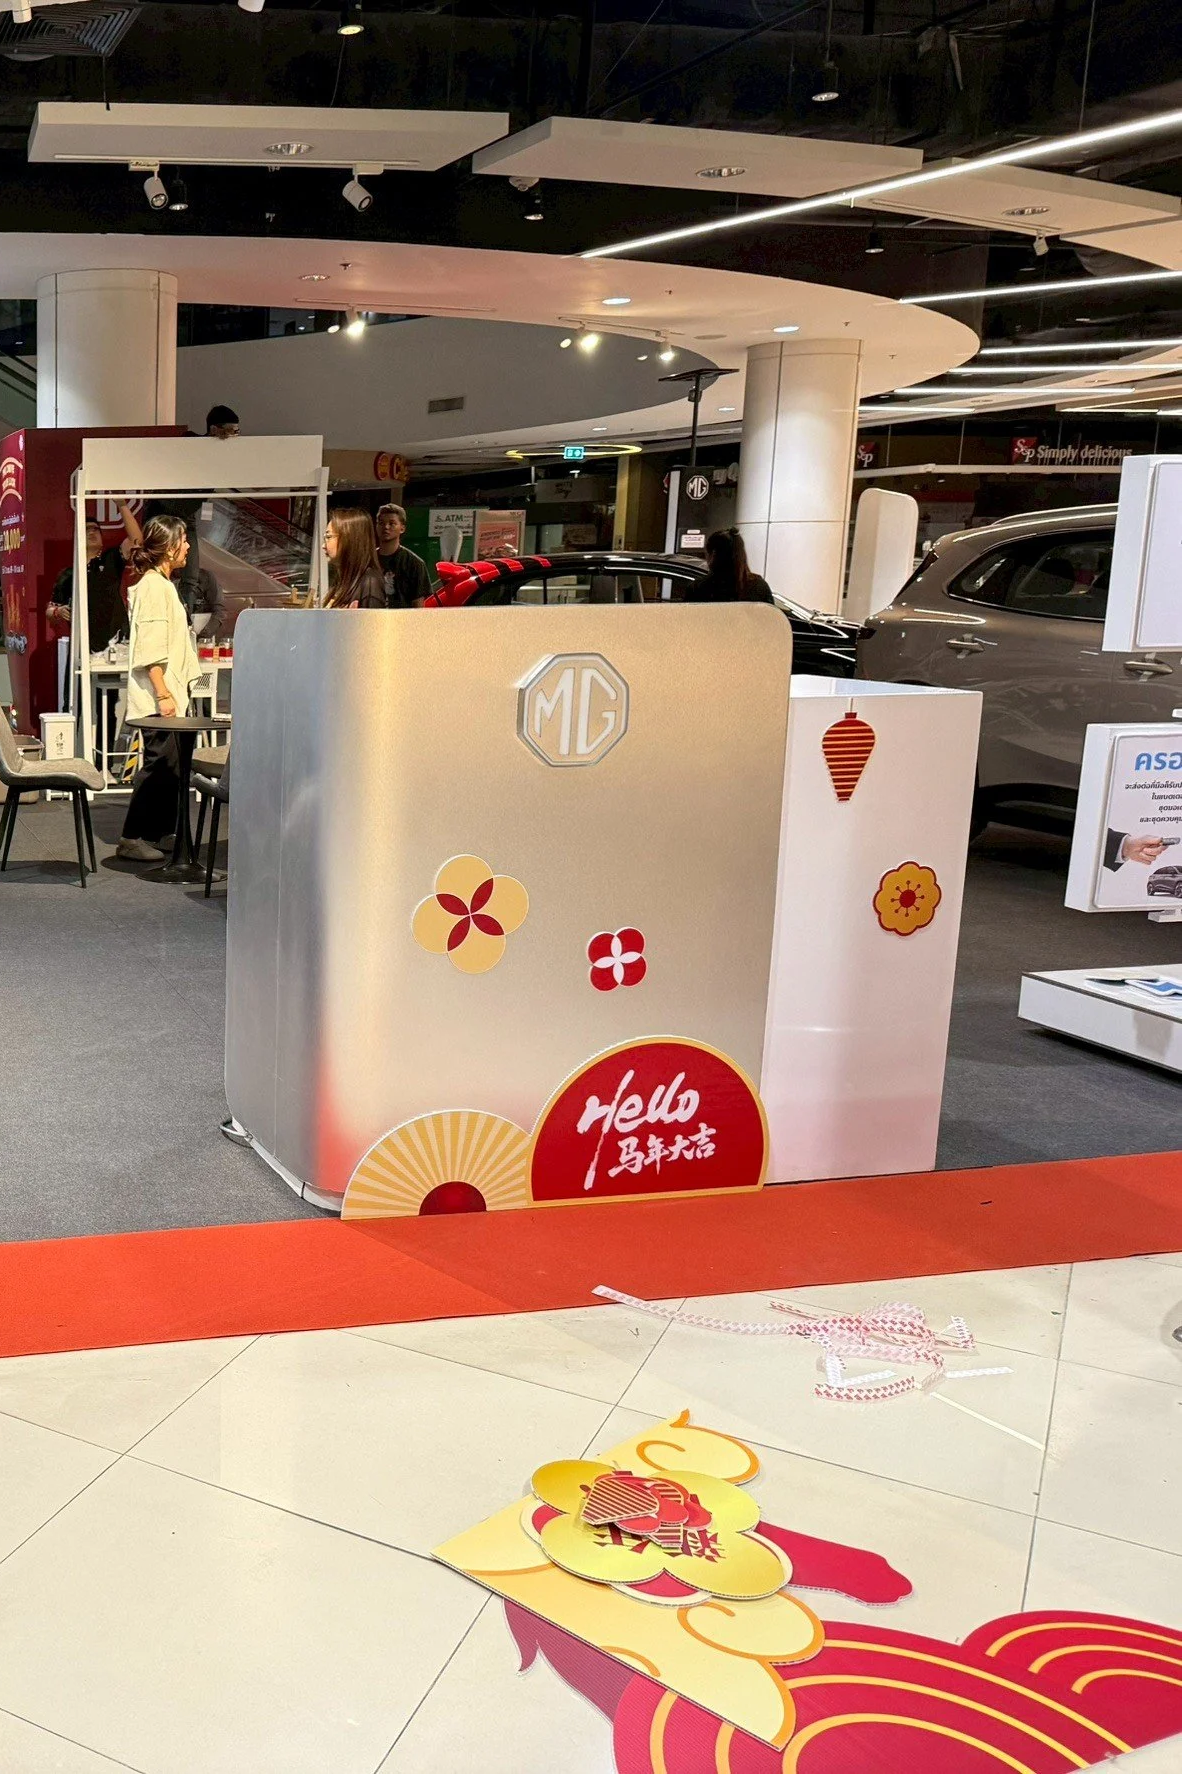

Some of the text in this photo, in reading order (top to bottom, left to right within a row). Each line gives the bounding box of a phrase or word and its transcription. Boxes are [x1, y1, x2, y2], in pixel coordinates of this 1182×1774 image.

[1037, 445, 1079, 462] Simply
[1080, 445, 1133, 459] delicious
[688, 477, 707, 498] MG
[445, 514, 464, 523] ATM
[534, 667, 618, 756] MG
[577, 1069, 700, 1190] Hello
[608, 1122, 717, 1178] 马年大吉
